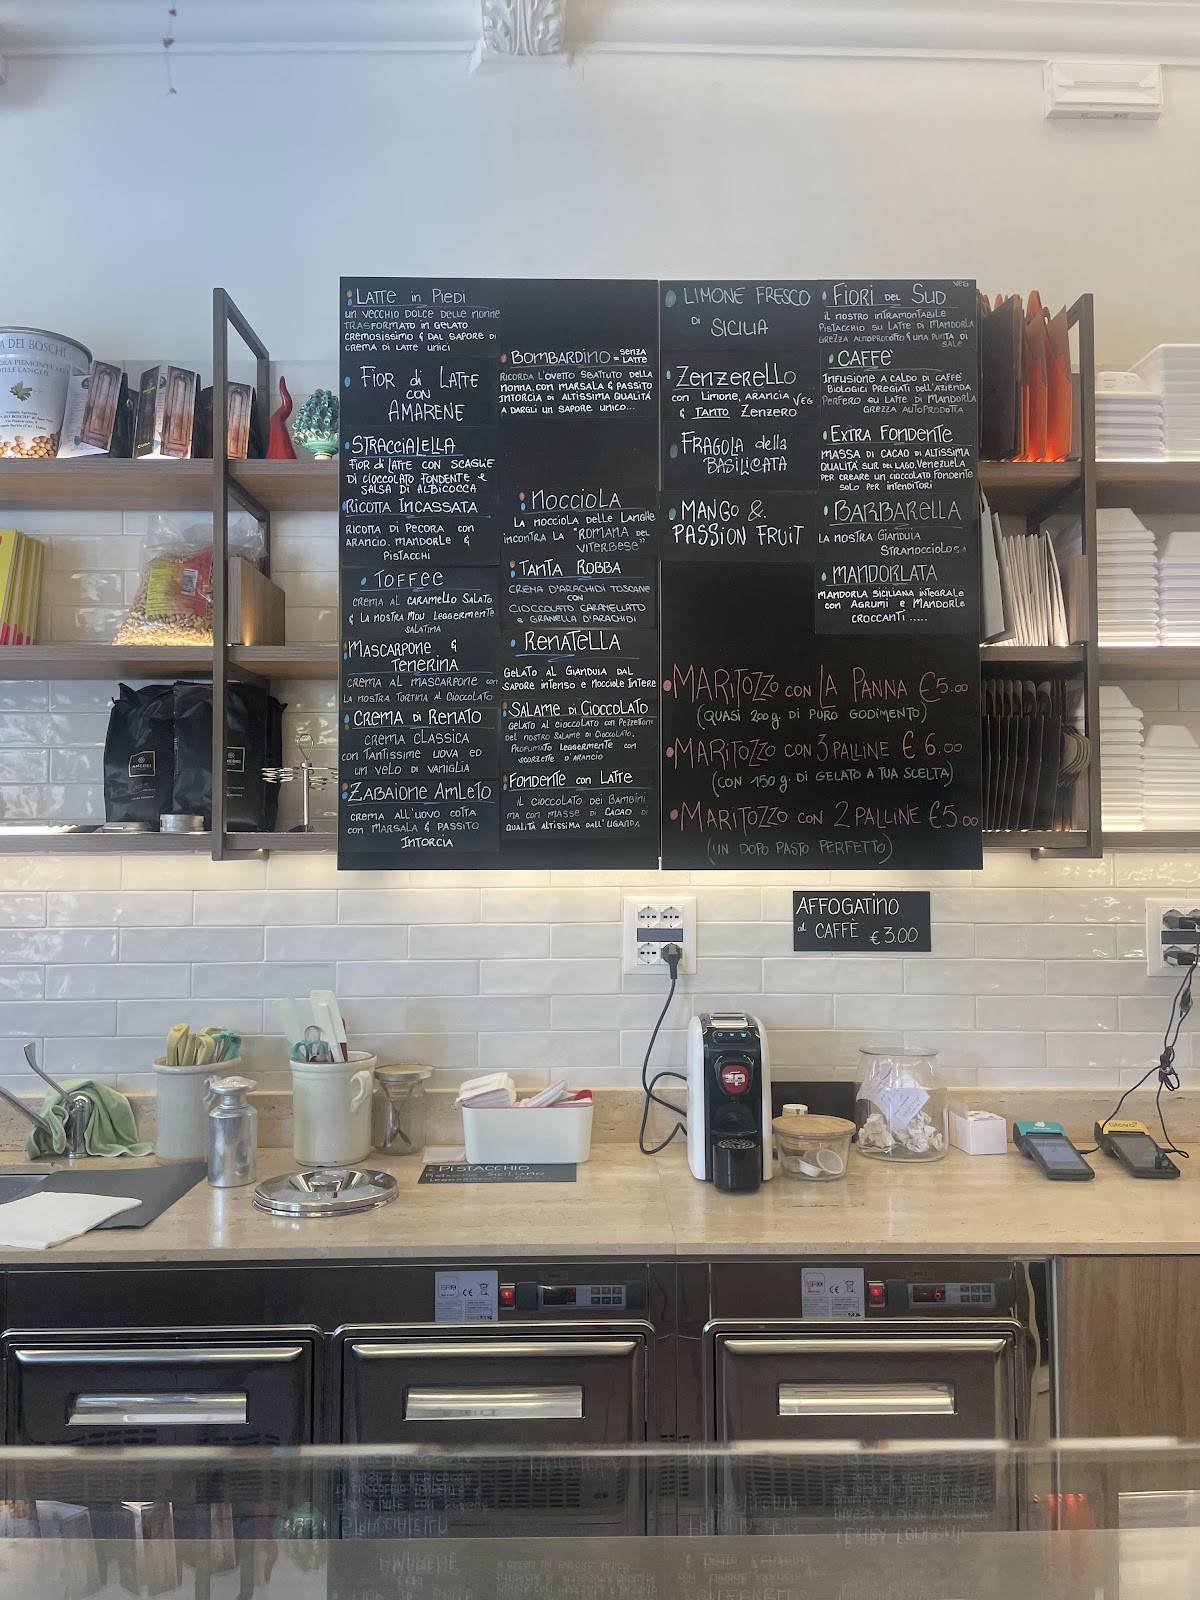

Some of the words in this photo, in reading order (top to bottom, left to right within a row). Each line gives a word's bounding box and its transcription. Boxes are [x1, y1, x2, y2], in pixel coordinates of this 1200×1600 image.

[684, 287, 745, 304] LIMONE
[756, 287, 811, 306] FRESCO
[912, 284, 946, 305] SUD
[711, 318, 768, 336] SICILIA
[9, 339, 24, 348] DEI
[410, 369, 422, 386] di
[440, 366, 479, 389] LATTE
[406, 390, 430, 399] CON
[388, 400, 465, 422] AMARENE
[681, 431, 744, 456] FRAGOLA
[755, 434, 787, 450] della
[822, 450, 861, 459] MASSA
[388, 458, 412, 473] LATTE
[422, 460, 441, 469] CON
[421, 473, 470, 484] FONDENTE
[361, 485, 391, 494] SALSA
[681, 499, 739, 522] MANGO
[672, 523, 746, 546] PASSION
[819, 533, 830, 543] LA
[577, 559, 621, 574] ROBBA
[390, 595, 400, 605] AL
[546, 666, 556, 676] AL
[617, 667, 633, 675] DAL
[673, 663, 779, 708] MARITOZZO
[785, 685, 811, 698] CON
[820, 665, 837, 708] LA
[853, 667, 907, 702] PANNA
[810, 708, 838, 721] PURO
[675, 738, 775, 769] MARITOZZO
[785, 745, 811, 757] CON
[817, 734, 828, 761] 3
[833, 741, 889, 761] PALLINE
[816, 769, 861, 781] GELATO
[867, 769, 874, 779] A
[878, 769, 898, 780] TUA
[904, 761, 953, 787] SCELTA)
[681, 801, 788, 836] MARITOZZO
[798, 811, 823, 824] CON
[834, 801, 850, 827] 2
[856, 804, 921, 828] PALLINE
[740, 843, 768, 855] DOPO
[776, 841, 808, 856] PASTO
[815, 918, 859, 938] CAFFÈ
